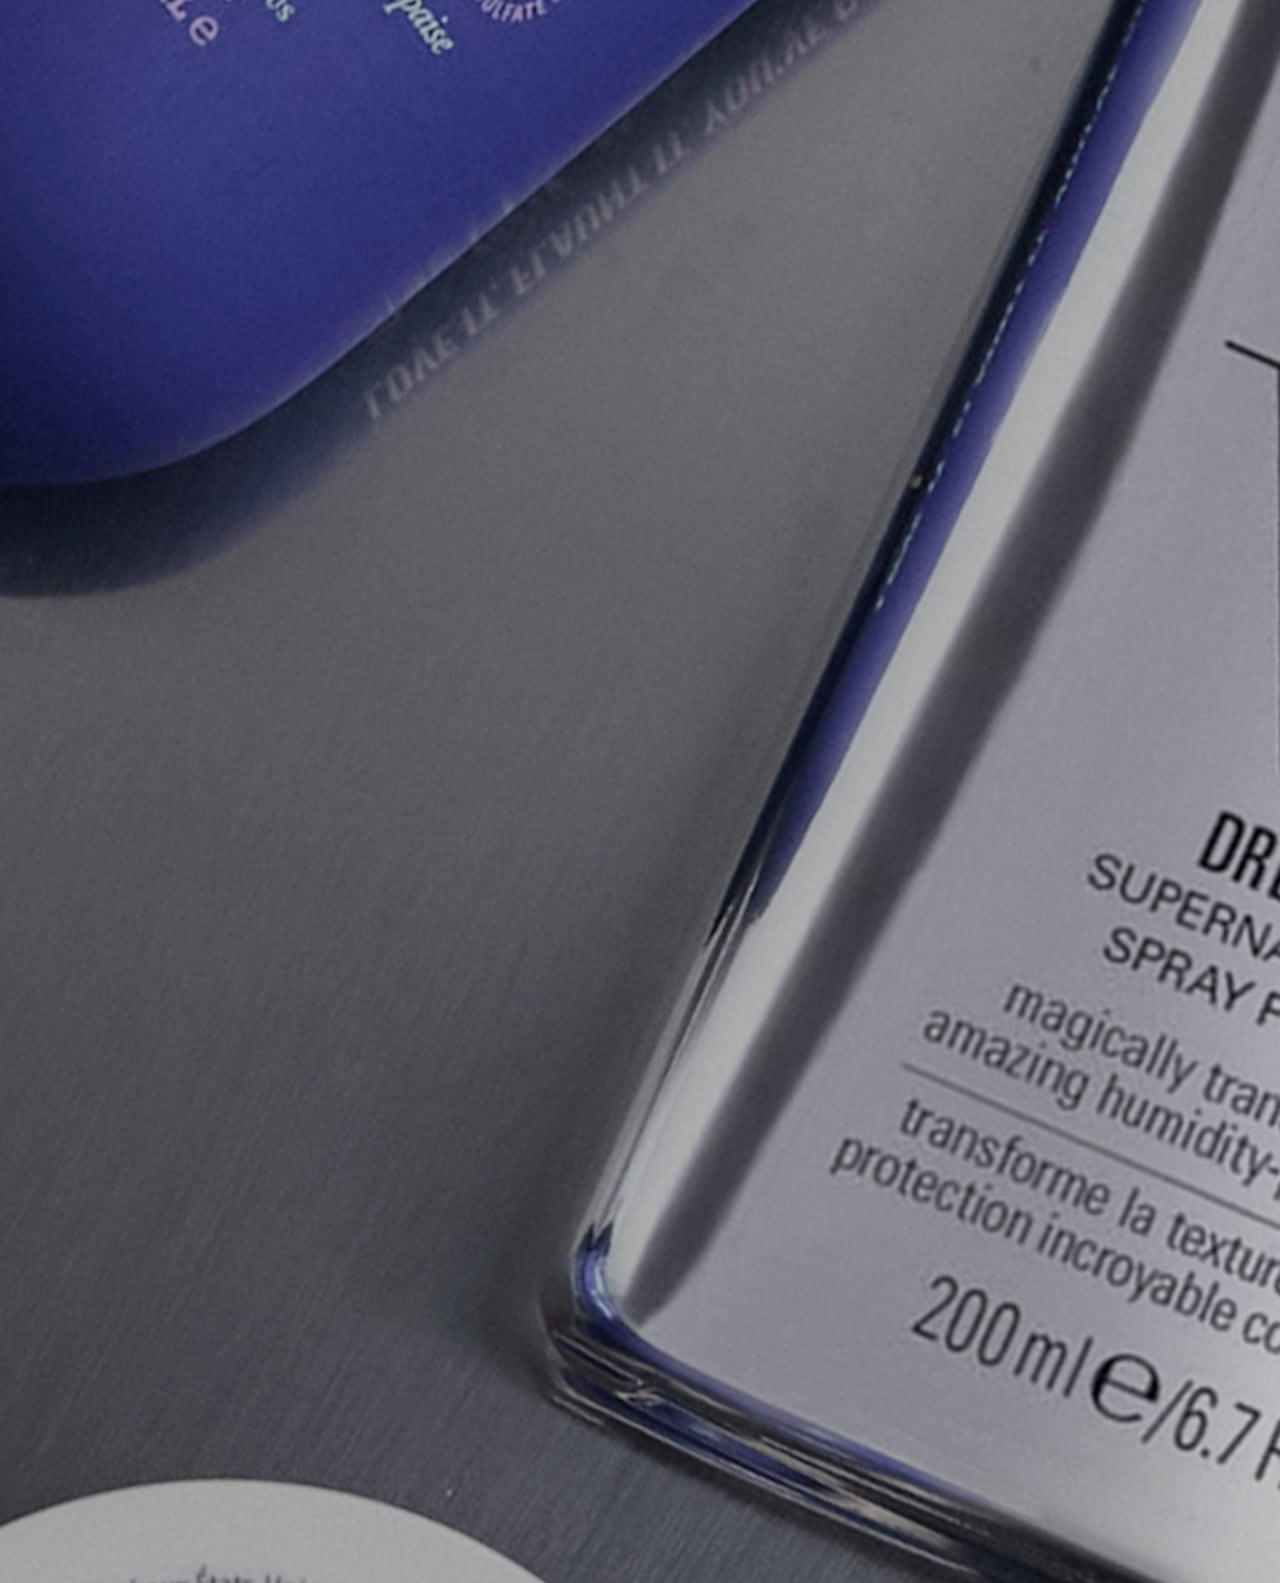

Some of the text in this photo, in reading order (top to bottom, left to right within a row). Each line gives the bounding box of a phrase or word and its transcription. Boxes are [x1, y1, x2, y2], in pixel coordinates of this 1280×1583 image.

[1103, 927, 1256, 1012] SPRAY
[924, 1011, 1090, 1111] amazing
[1004, 985, 1199, 1094] magically
[900, 1099, 1111, 1216] transforme
[1118, 1186, 1157, 1237] la
[830, 1138, 1033, 1245] protection
[1038, 1224, 1237, 1333] incroyable
